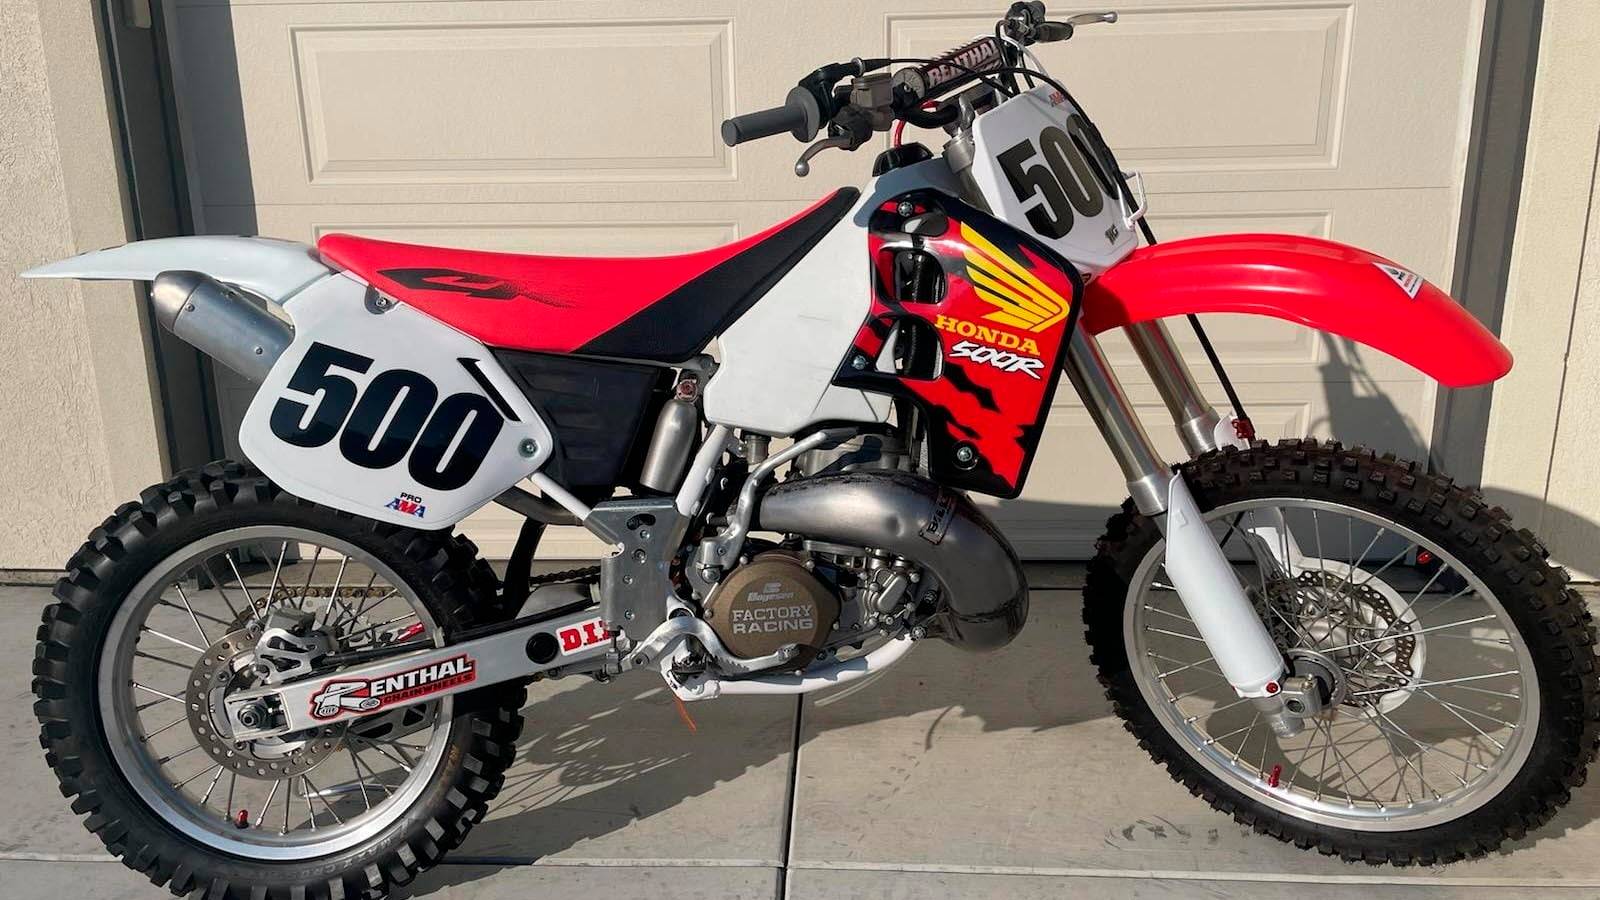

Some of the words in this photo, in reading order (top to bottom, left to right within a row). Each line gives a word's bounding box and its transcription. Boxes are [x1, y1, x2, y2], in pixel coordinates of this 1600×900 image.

[996, 113, 1120, 240] 500
[935, 314, 1041, 357] HONDA
[949, 340, 1045, 380] 500R
[269, 341, 505, 491] 500
[384, 497, 426, 519] AMA
[400, 492, 422, 504] PRO
[732, 604, 813, 622] FACTORY
[733, 618, 815, 635] RACING
